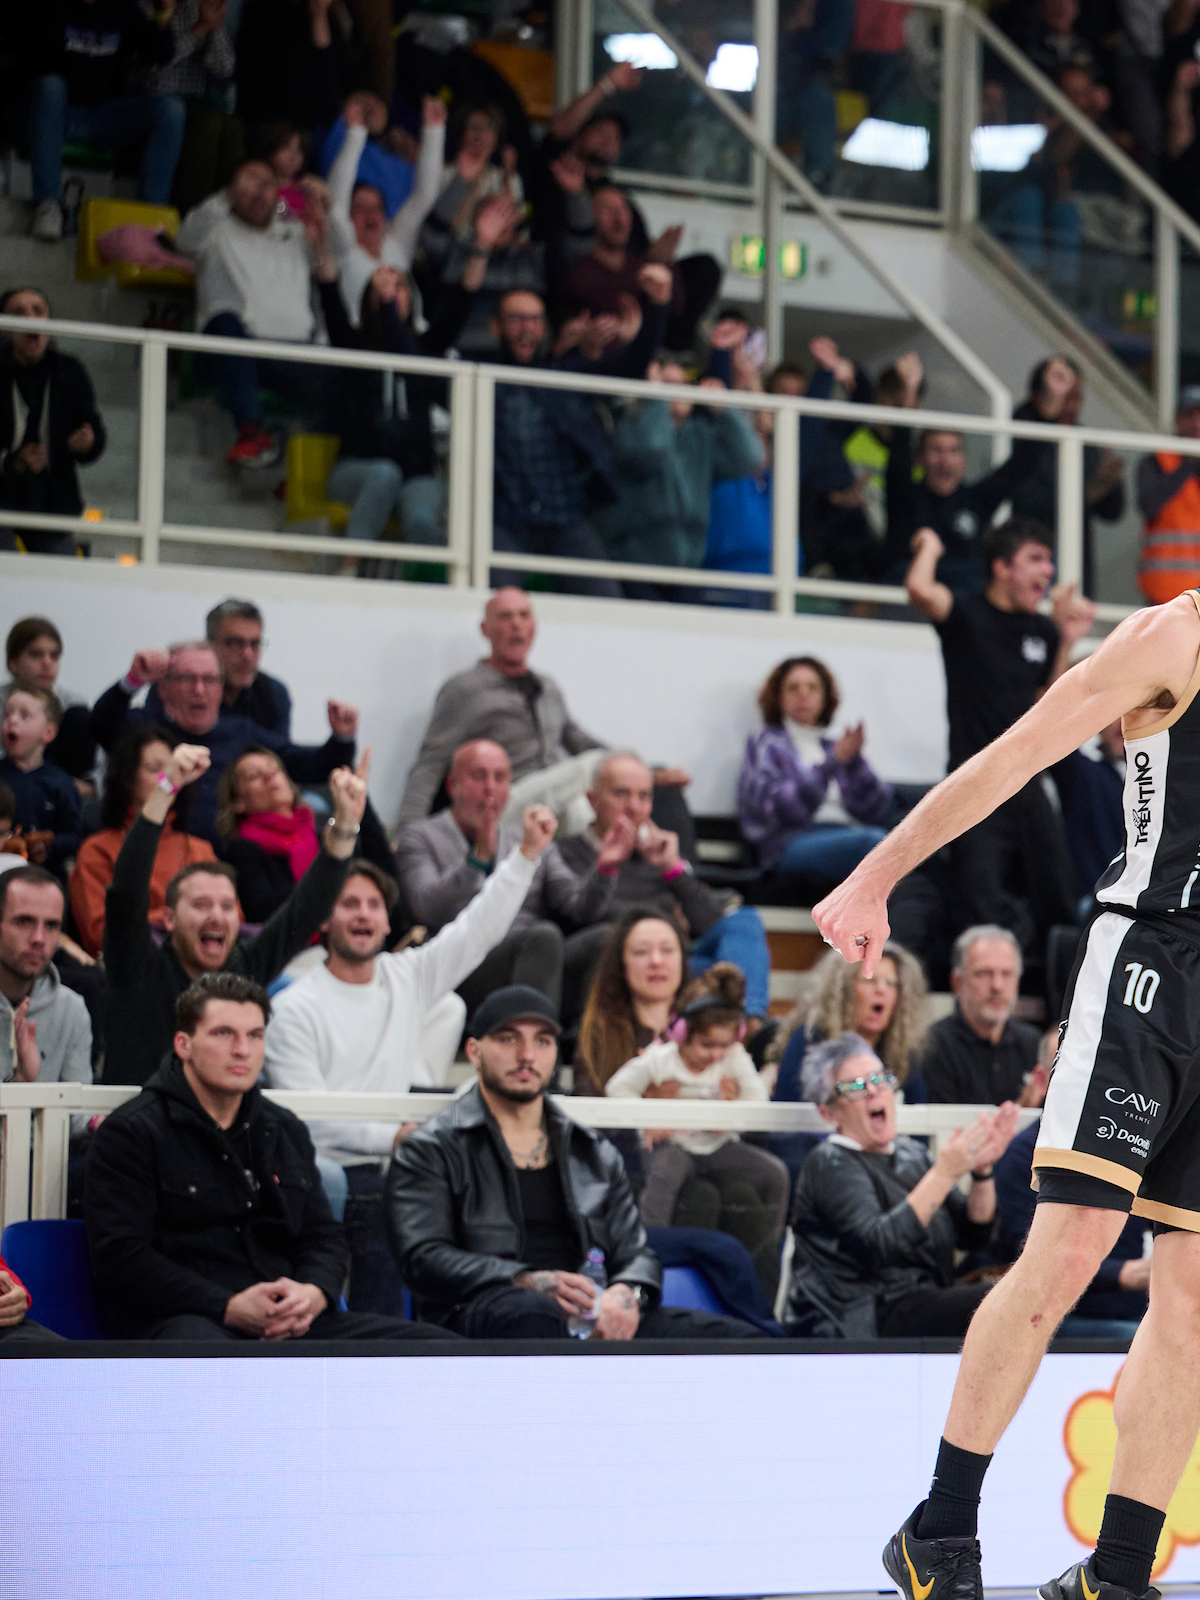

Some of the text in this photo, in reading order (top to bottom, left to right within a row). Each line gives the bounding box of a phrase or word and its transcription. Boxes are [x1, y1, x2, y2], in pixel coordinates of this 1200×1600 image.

[1133, 751, 1155, 847] TRENTINO
[1122, 961, 1161, 1014] 10
[1104, 1087, 1161, 1118] CAVIT
